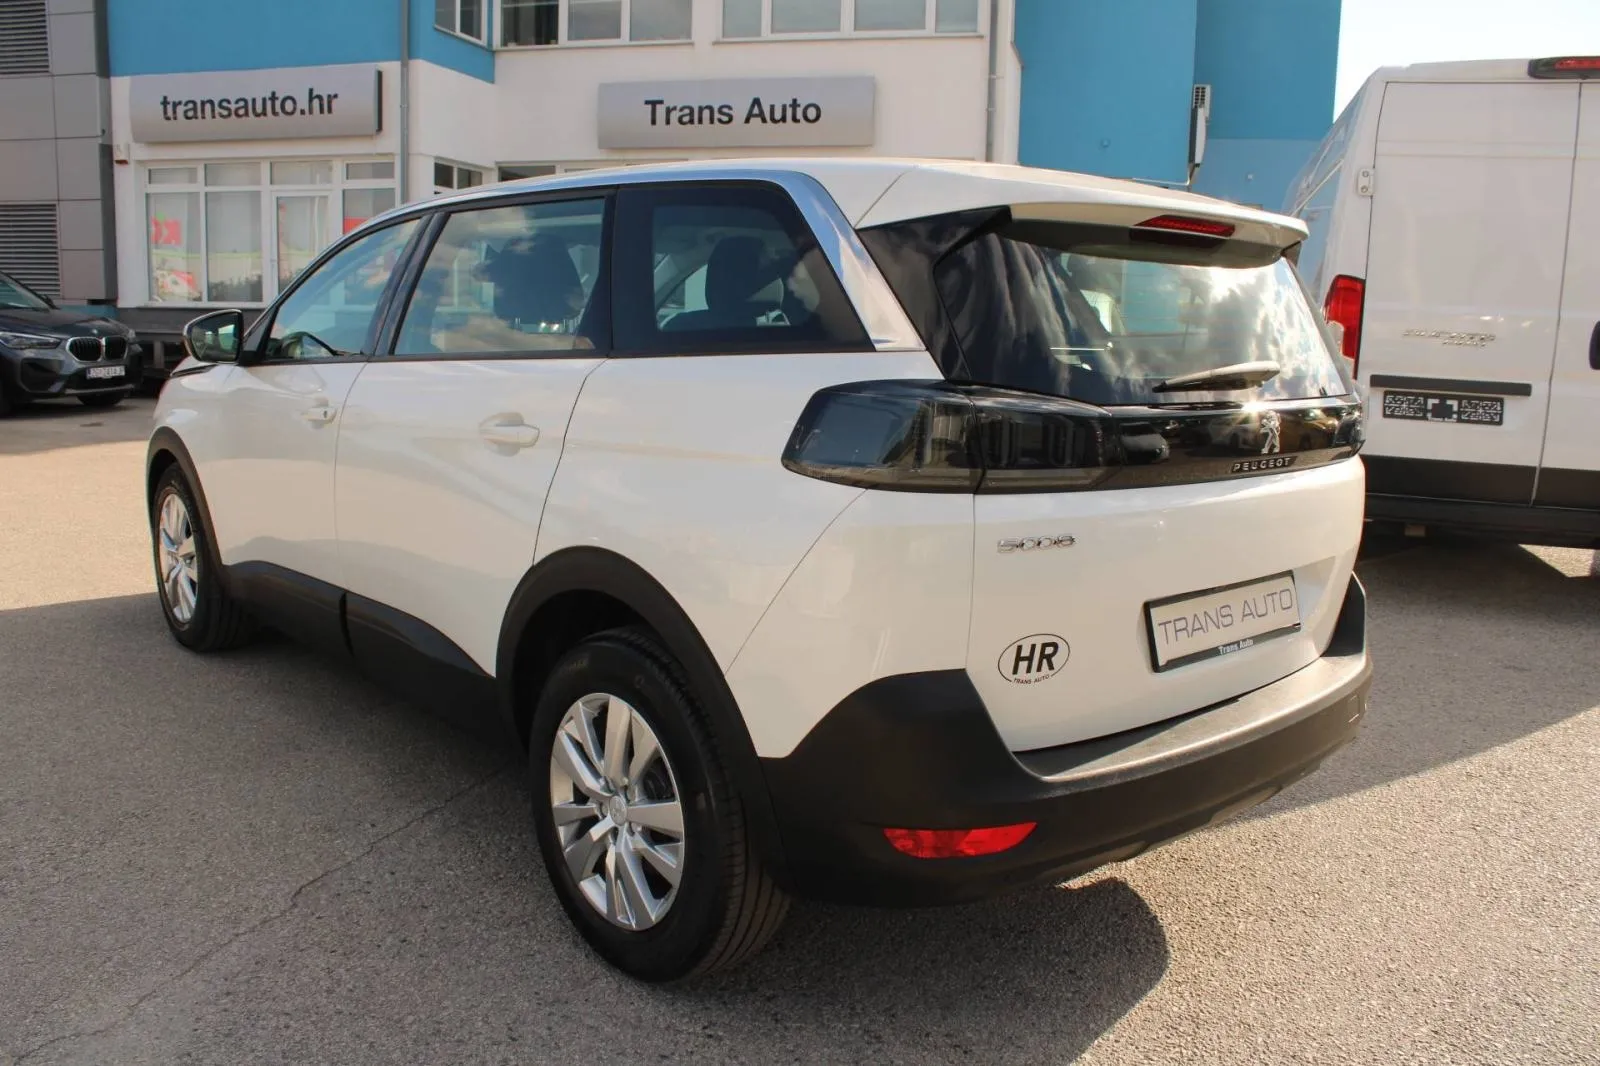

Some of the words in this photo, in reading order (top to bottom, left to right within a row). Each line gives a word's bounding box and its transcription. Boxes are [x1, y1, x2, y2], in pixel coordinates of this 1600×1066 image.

[160, 88, 339, 121] transauto.hr
[644, 99, 734, 126] Trans
[744, 97, 822, 124] Auto
[1232, 457, 1291, 472] PEUGEOT
[997, 534, 1076, 553] 5008
[1158, 604, 1234, 645] TRANS
[1240, 588, 1294, 622] AUTO
[1012, 641, 1059, 675] HR
[1013, 677, 1032, 685] TRANS
[1034, 674, 1050, 683] AUTO
